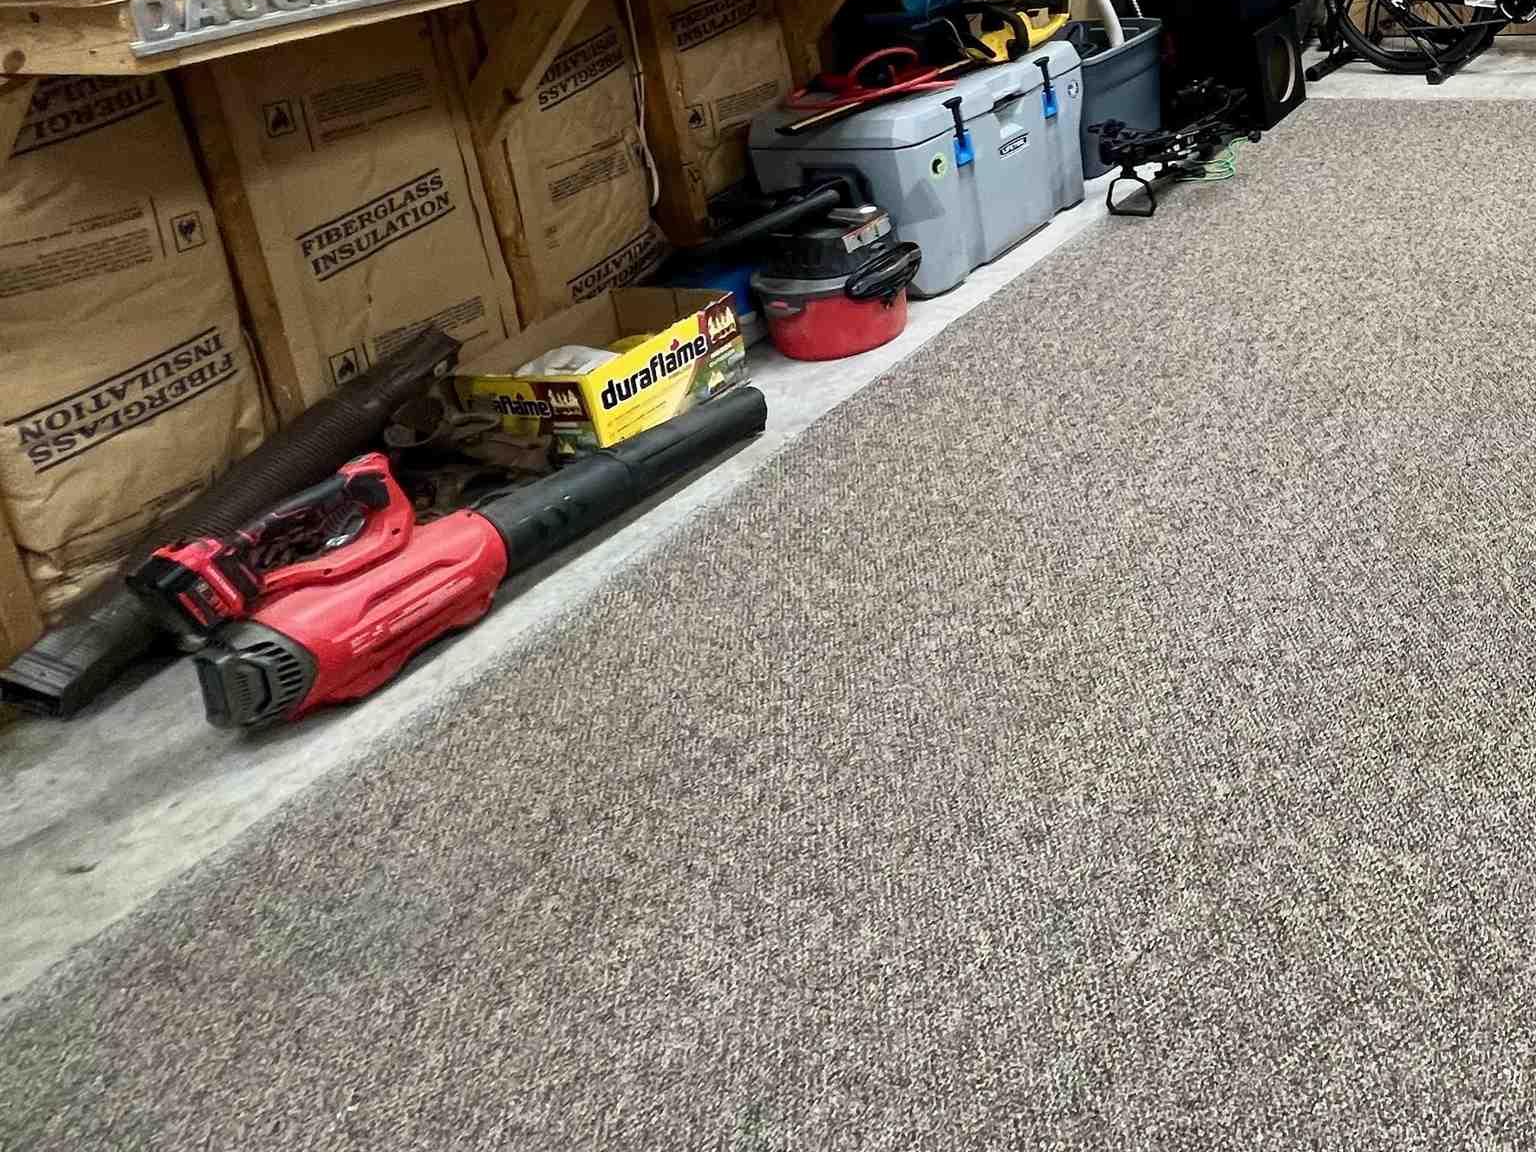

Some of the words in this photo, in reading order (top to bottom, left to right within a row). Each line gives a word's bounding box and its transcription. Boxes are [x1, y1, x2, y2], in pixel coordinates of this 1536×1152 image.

[301, 175, 444, 258] FIBERGLASS
[311, 191, 450, 276] INSULATION
[18, 334, 224, 445] INSULATION
[27, 351, 233, 465] FIBERGLASS
[600, 333, 706, 410] duraflame
